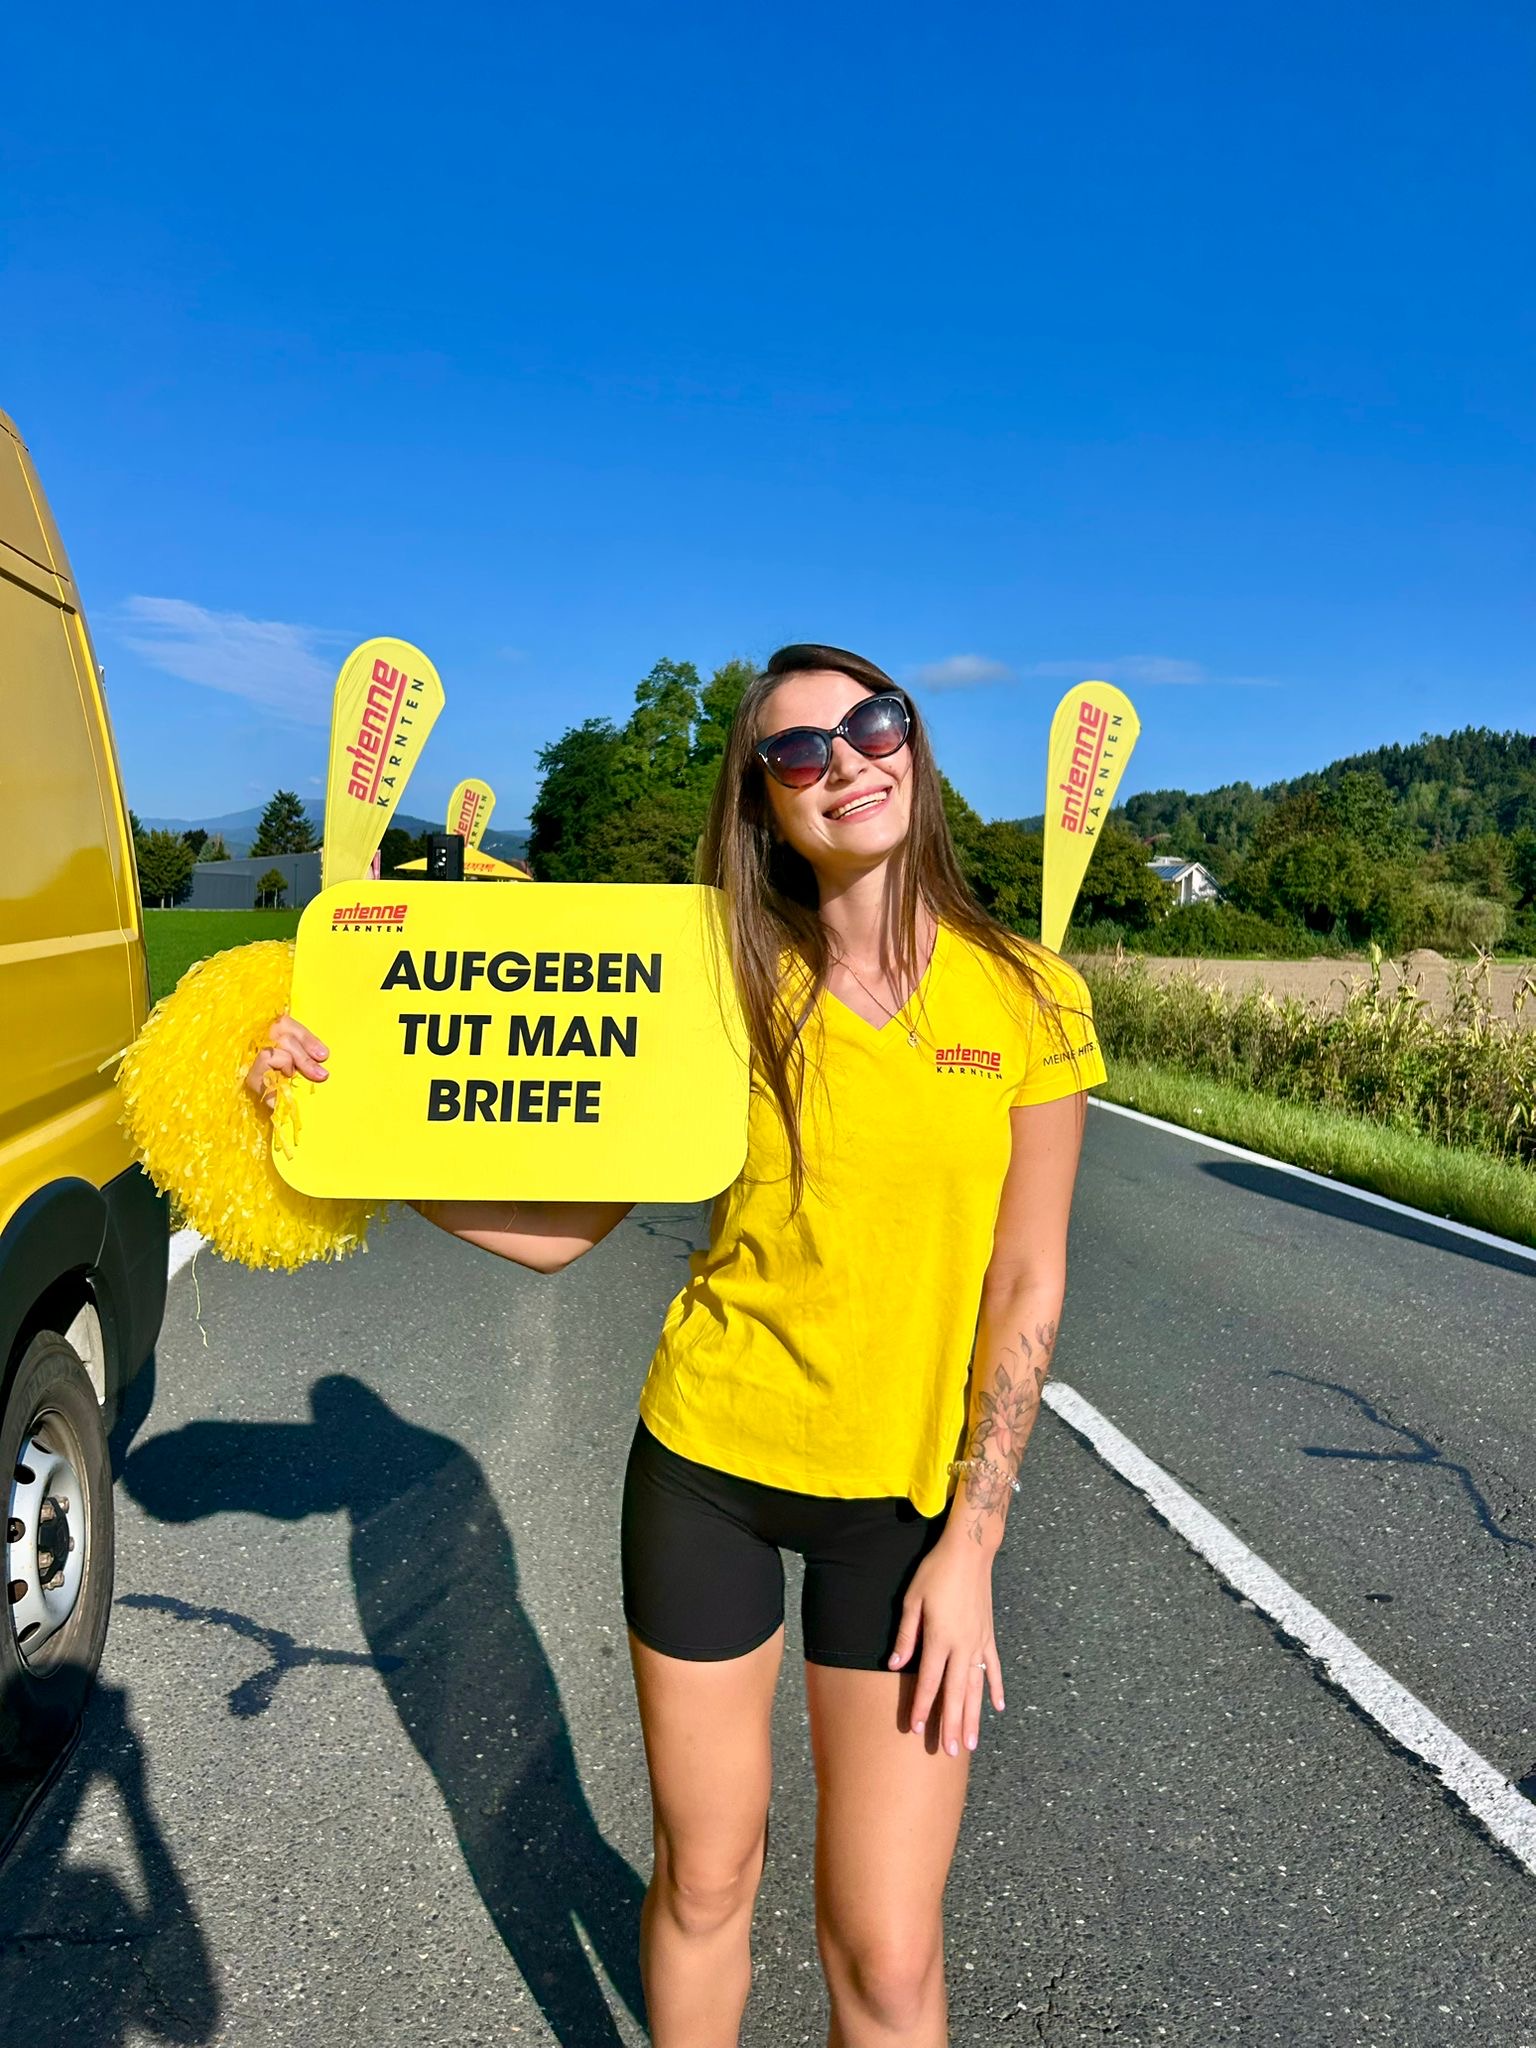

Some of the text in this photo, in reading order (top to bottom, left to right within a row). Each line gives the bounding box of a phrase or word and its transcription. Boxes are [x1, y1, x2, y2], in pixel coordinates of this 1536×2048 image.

[347, 658, 397, 802] antenne
[377, 678, 425, 808] KÄRNTEN
[1059, 701, 1101, 833] antenne
[1085, 715, 1123, 836] KÄRNTEN
[453, 788, 477, 837] tenne
[332, 923, 404, 933] KÄRNTEN
[333, 902, 408, 920] antenne
[380, 950, 662, 993] AUFGEBEN
[399, 1013, 638, 1058] TUT MAN
[935, 1043, 1001, 1067] antenne
[1043, 1049, 1076, 1067] MEINE
[427, 1079, 602, 1123] BRIEFE
